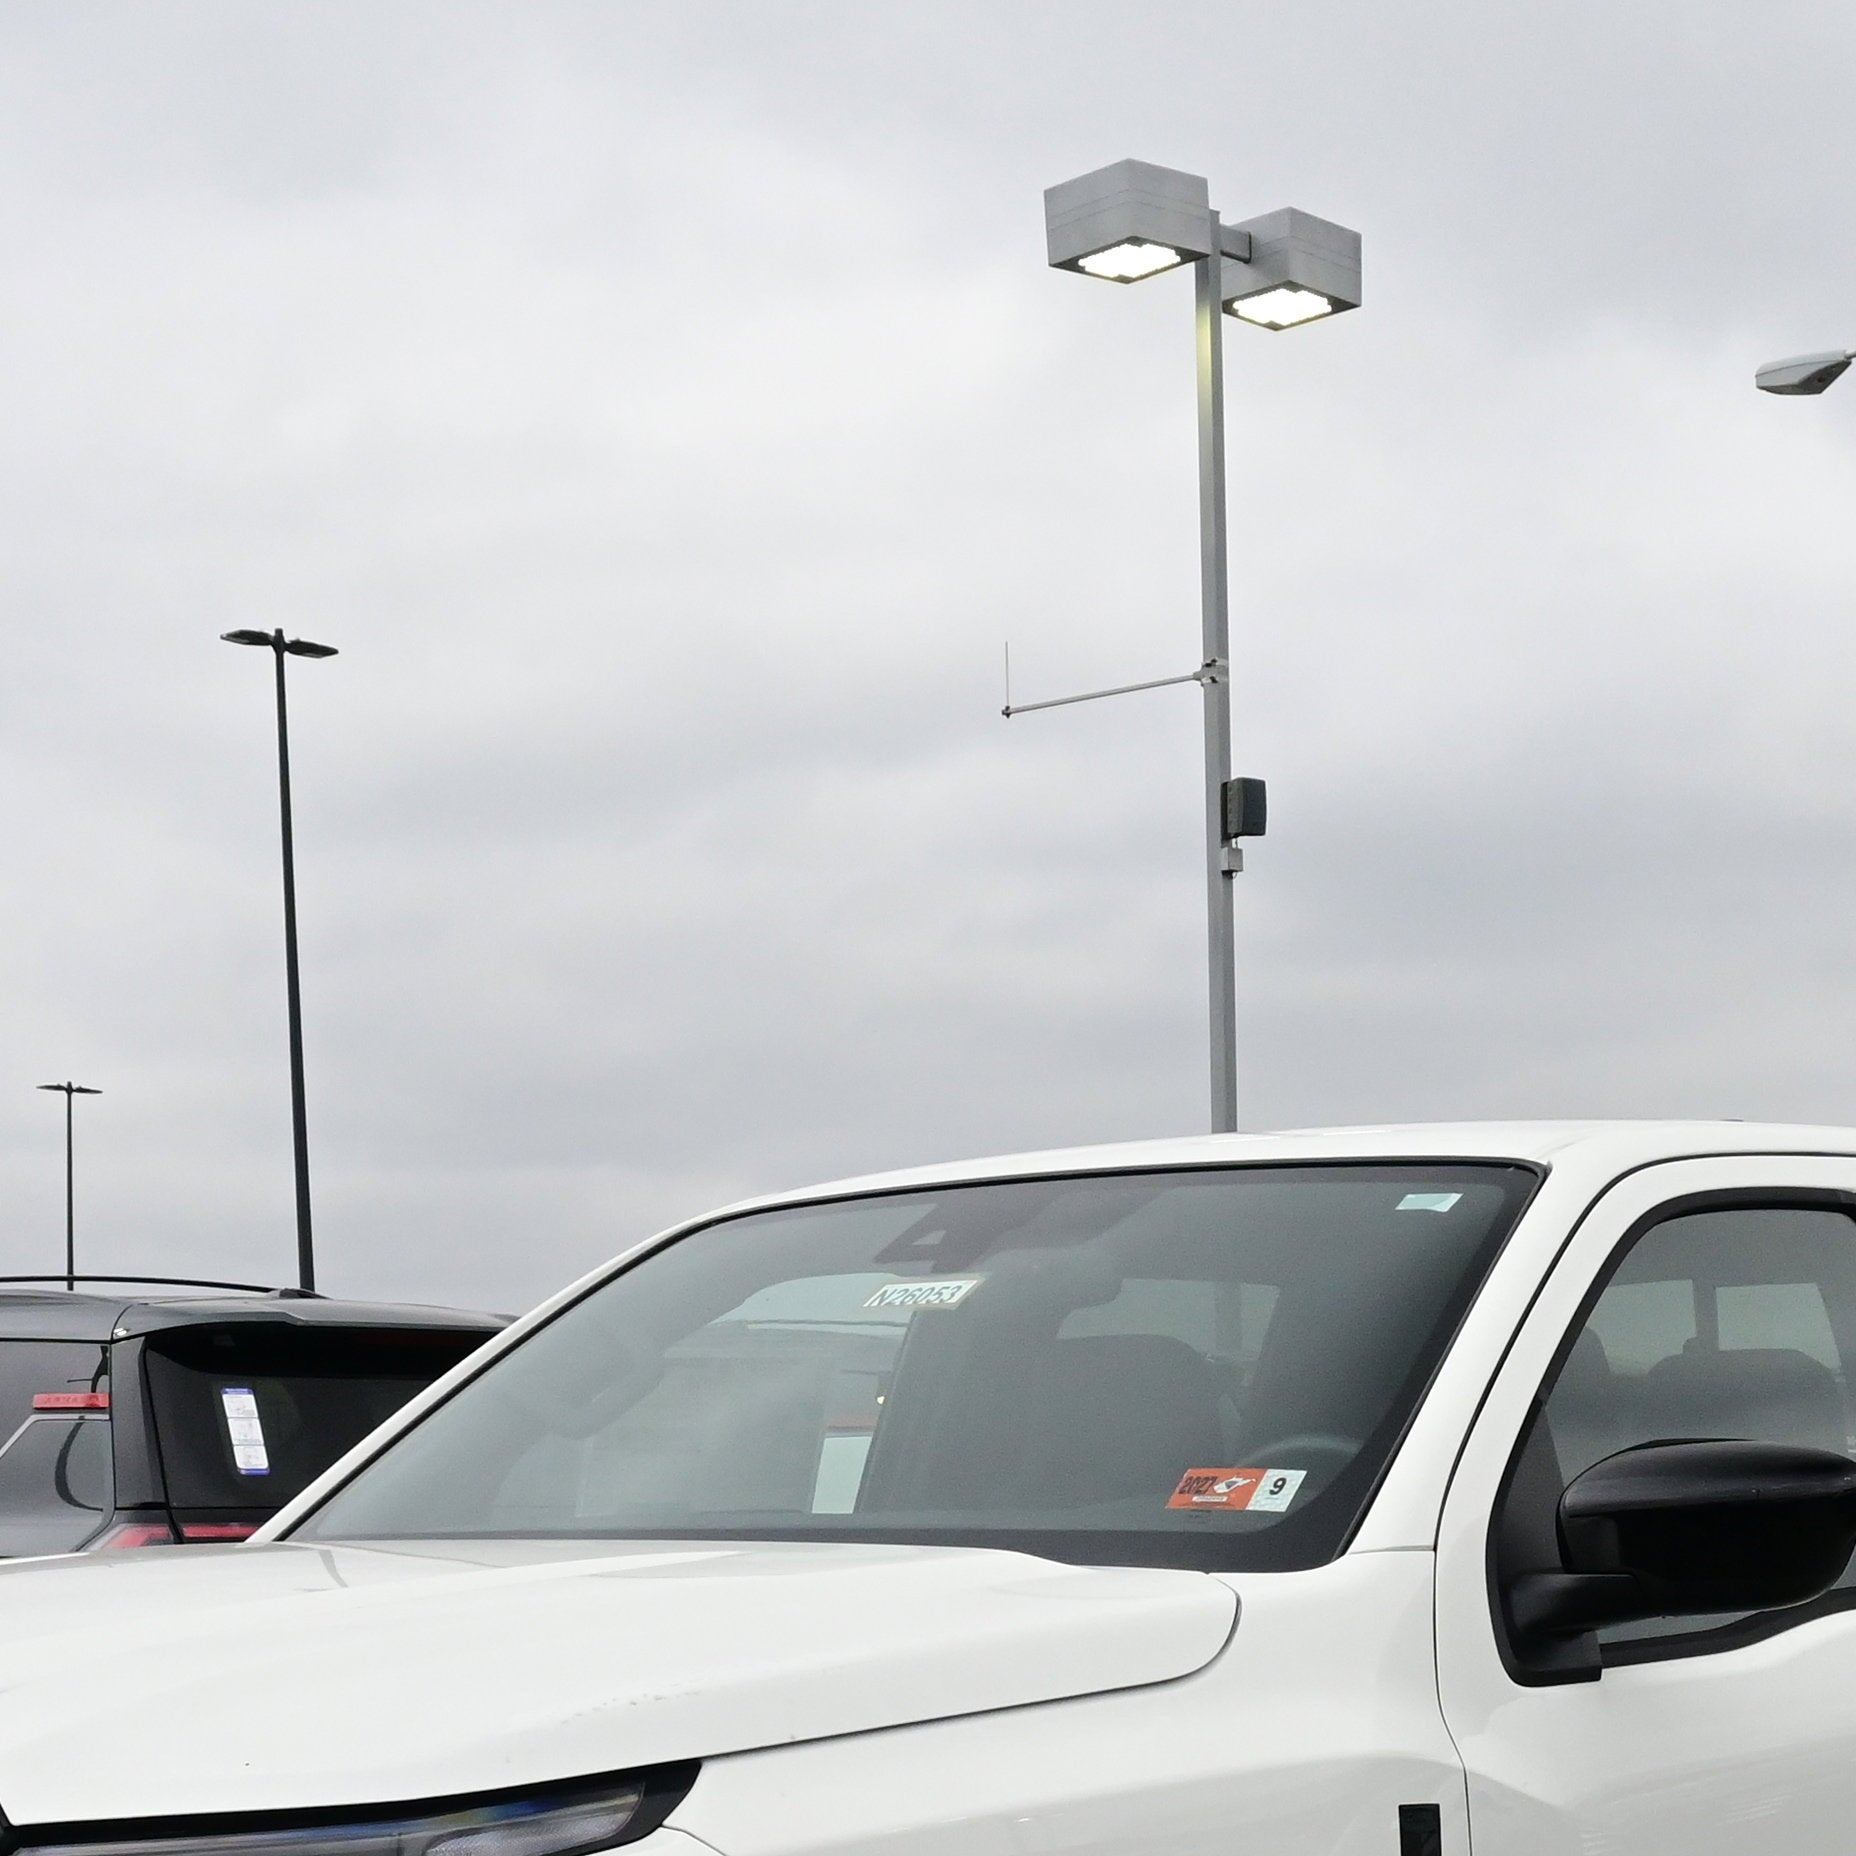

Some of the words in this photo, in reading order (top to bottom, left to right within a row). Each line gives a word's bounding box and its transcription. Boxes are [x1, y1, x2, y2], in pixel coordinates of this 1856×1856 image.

[872, 1285, 963, 1304] N26053
[1178, 1475, 1218, 1496] 2027
[1269, 1477, 1287, 1495] 9
